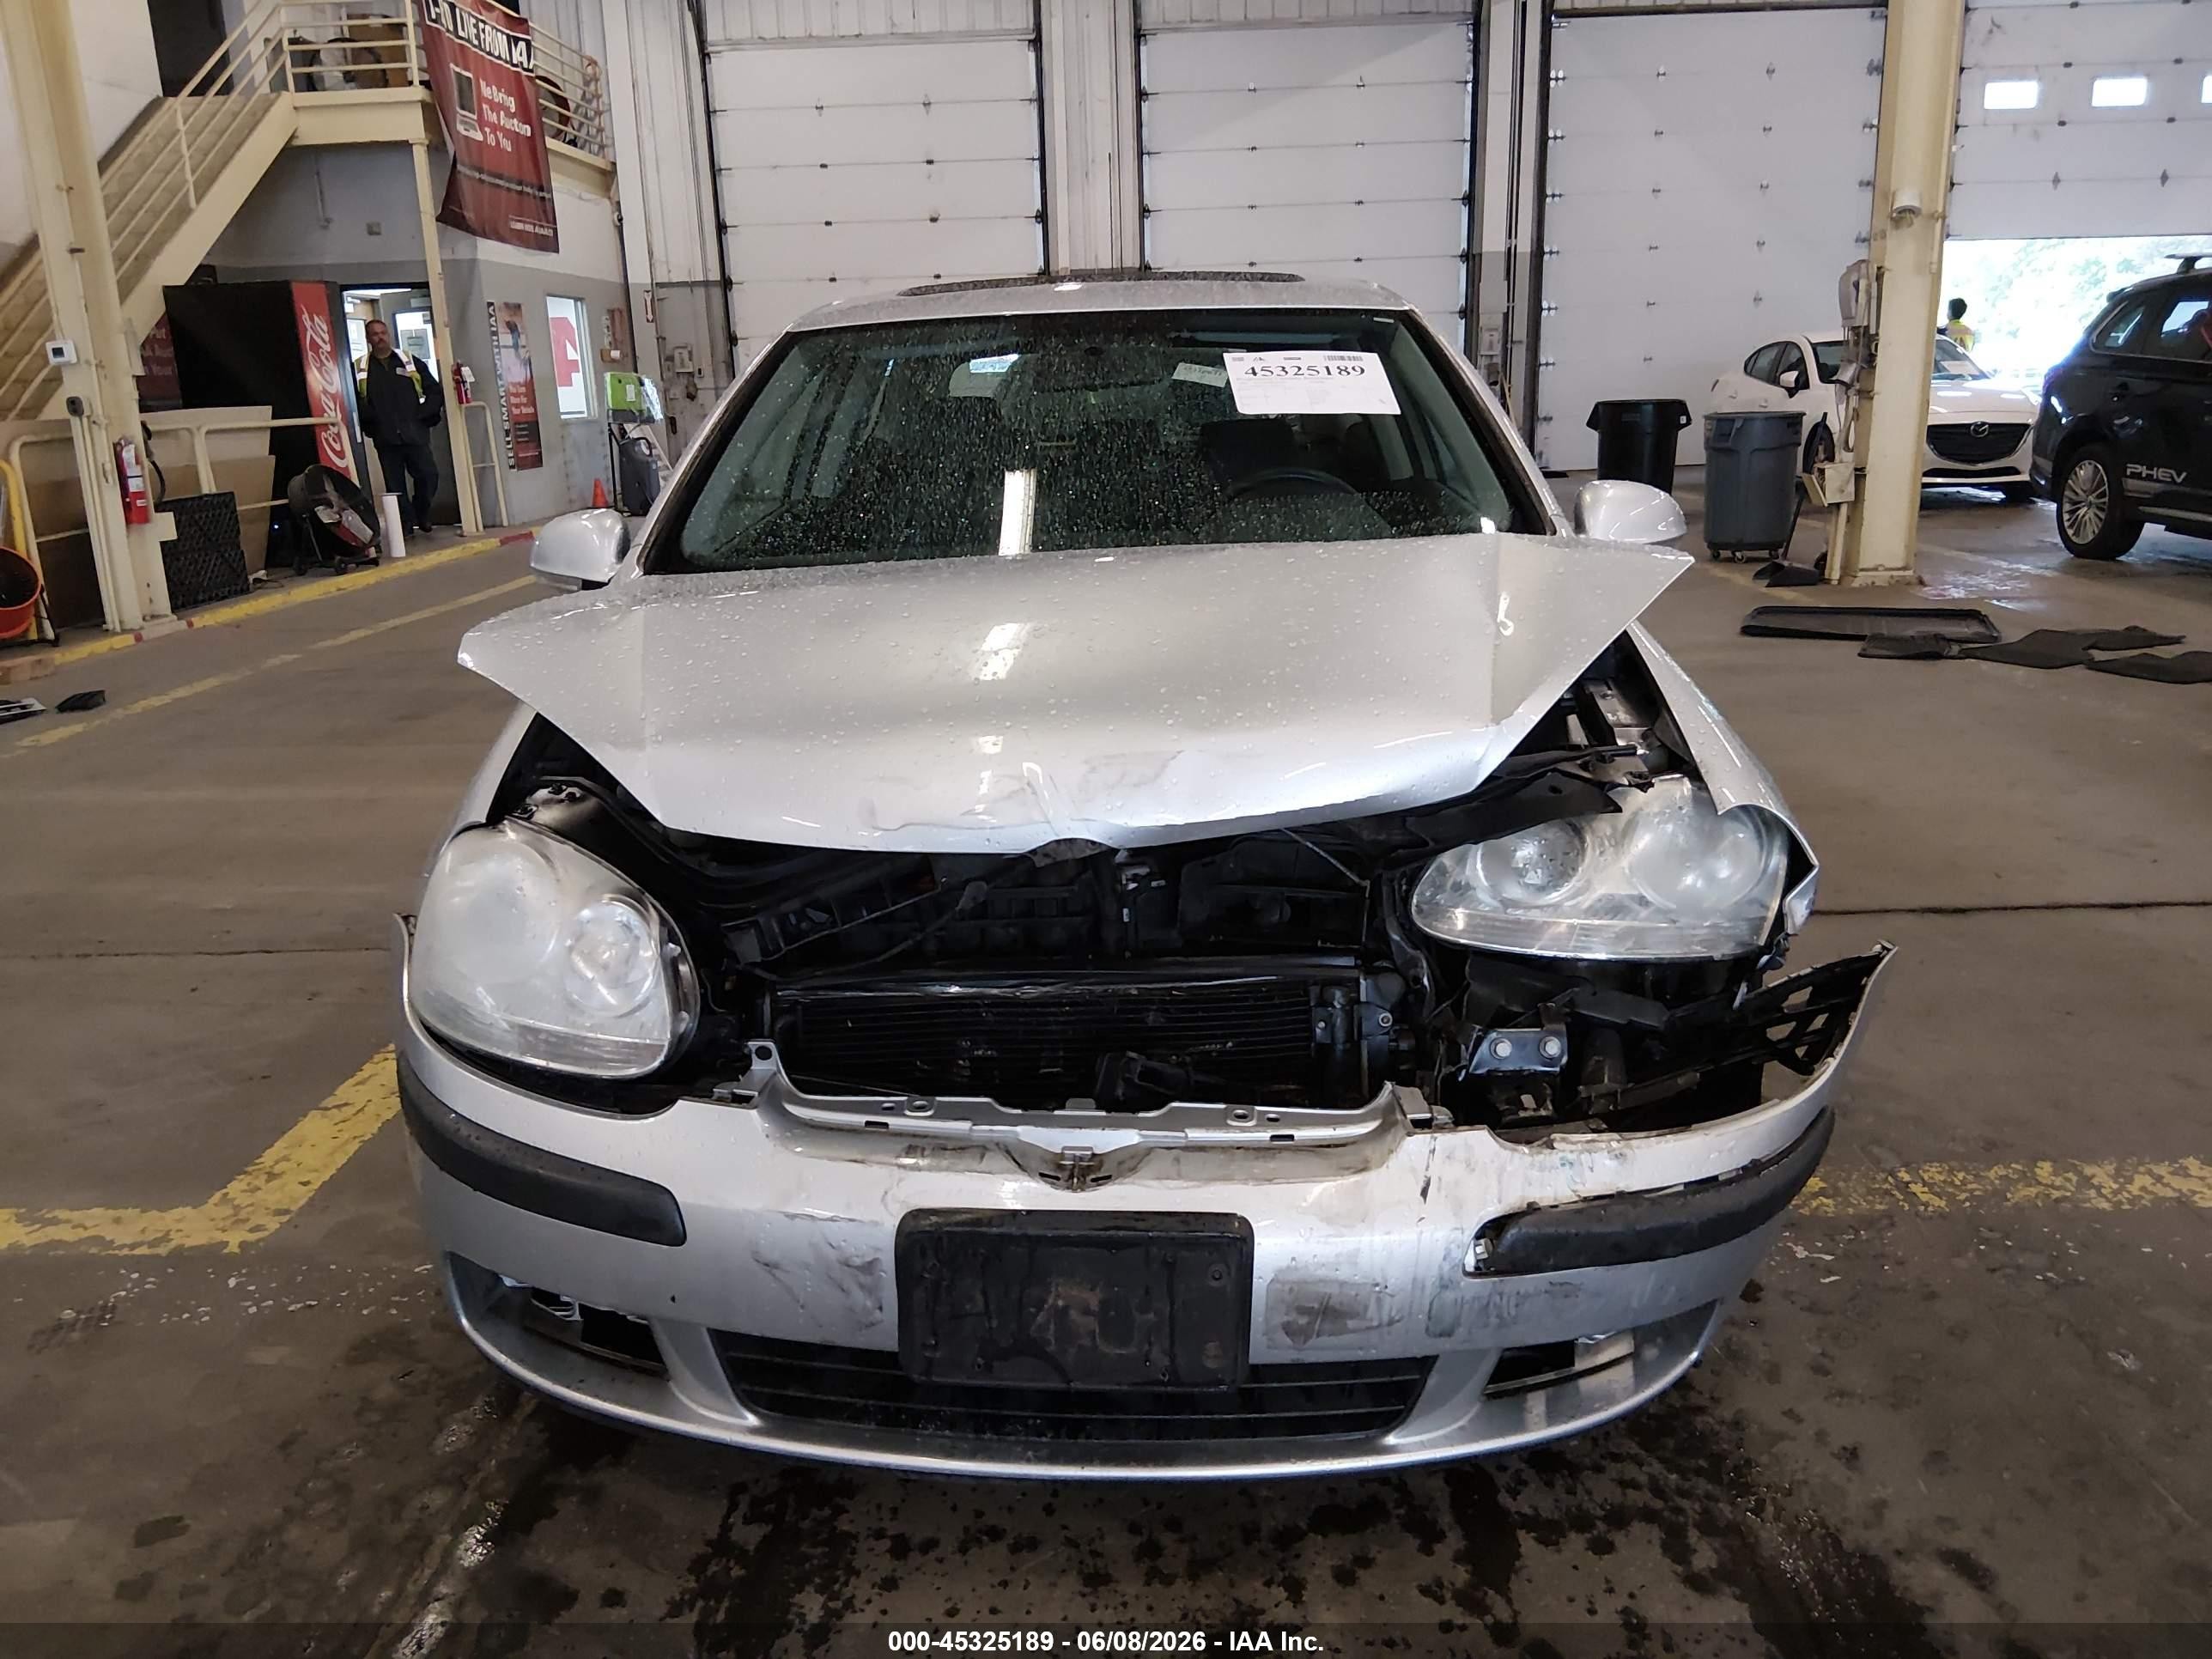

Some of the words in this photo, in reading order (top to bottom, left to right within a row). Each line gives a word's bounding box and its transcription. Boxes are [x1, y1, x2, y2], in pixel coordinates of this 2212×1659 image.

[478, 20, 510, 61] FROM
[482, 103, 498, 125] The
[484, 127, 495, 147] To
[496, 131, 512, 152] You
[488, 306, 497, 331] IAA
[1244, 365, 1365, 377] 45325189
[497, 380, 511, 429] SMART
[2125, 464, 2188, 483] PHEV
